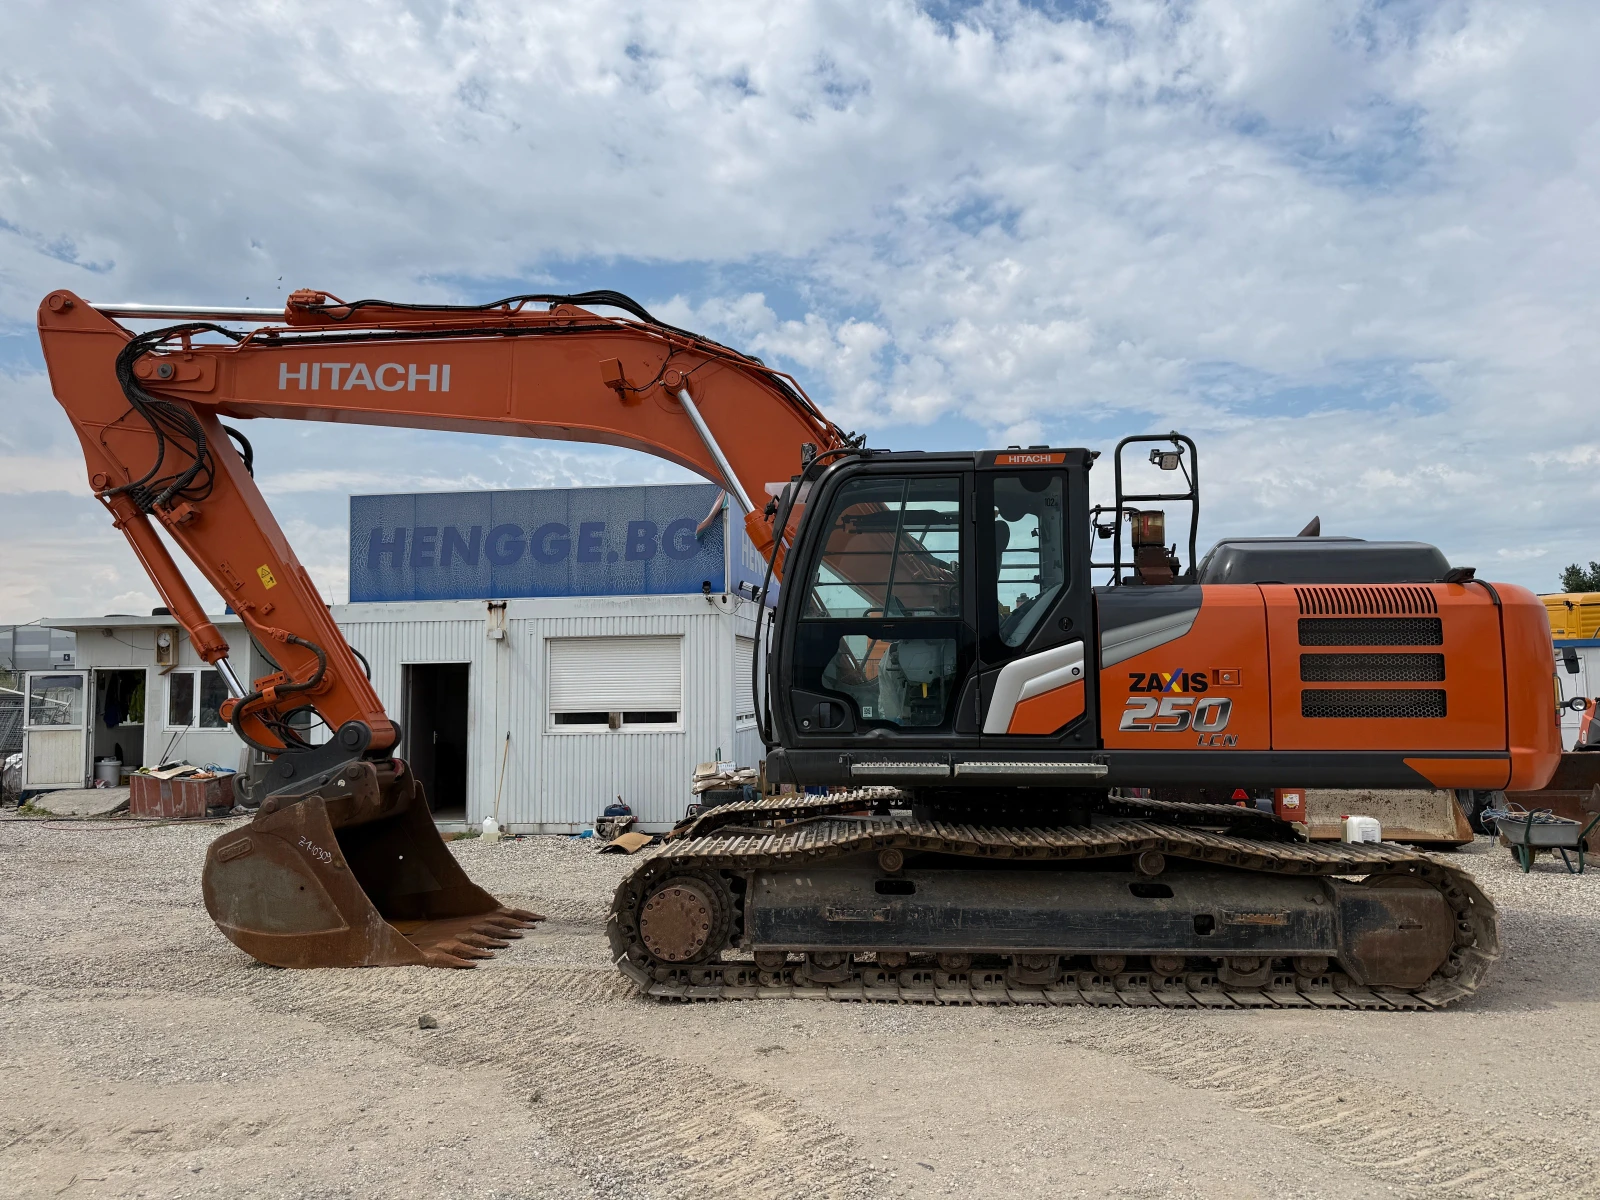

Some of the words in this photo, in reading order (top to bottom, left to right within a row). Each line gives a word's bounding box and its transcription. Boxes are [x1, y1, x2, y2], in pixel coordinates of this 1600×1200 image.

[278, 362, 451, 392] HITACHI
[1008, 455, 1051, 463] HITACHI
[367, 518, 702, 568] HENGGE.BG
[1128, 668, 1208, 693] ZAXIS
[1119, 696, 1233, 732] 250
[1197, 733, 1238, 747] LCN
